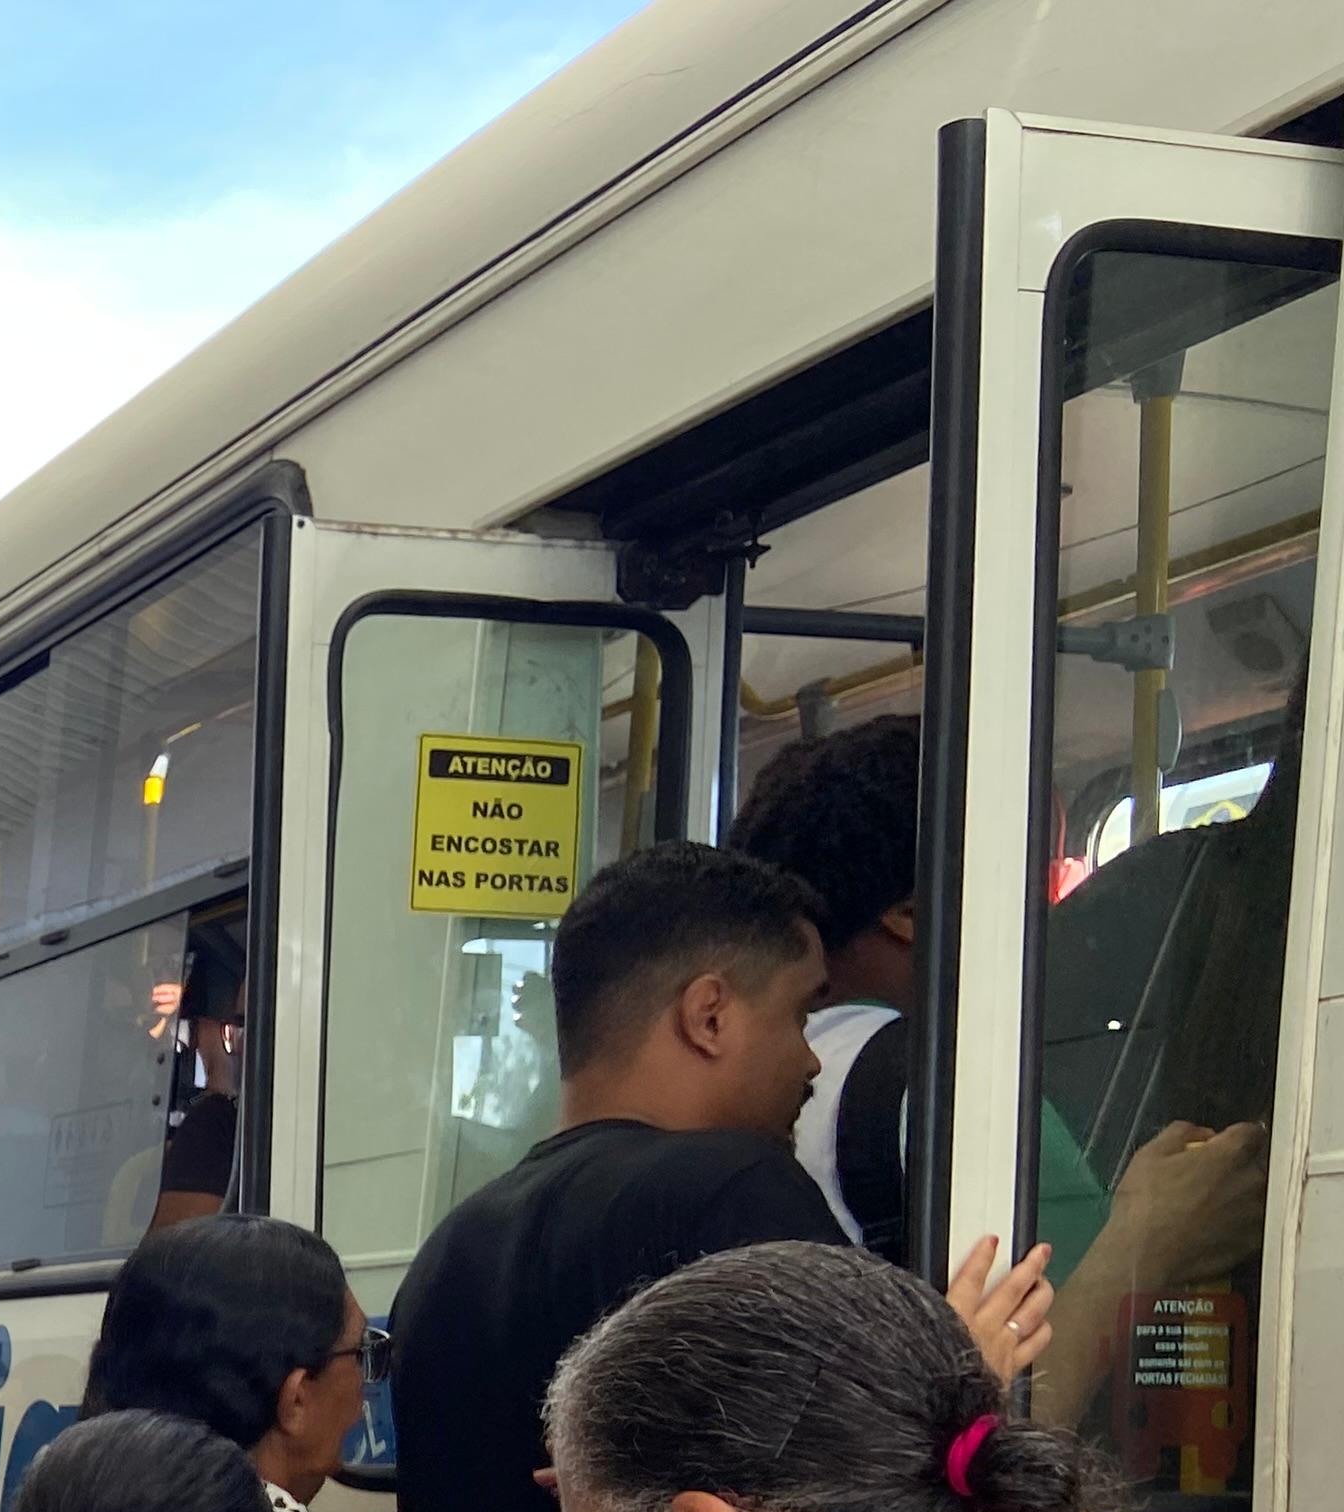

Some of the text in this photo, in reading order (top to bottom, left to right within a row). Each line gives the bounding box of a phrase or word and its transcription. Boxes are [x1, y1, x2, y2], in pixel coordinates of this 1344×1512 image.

[448, 755, 552, 781] ATENÇÃO
[472, 798, 523, 820] NÃO
[430, 834, 560, 858] ENCOSTAR
[418, 870, 466, 888] NAS
[475, 872, 569, 894] PORTAS
[1153, 1298, 1214, 1315] ATENÇÃO
[1136, 1325, 1156, 1337] para
[1135, 1372, 1173, 1385] PORTAS
